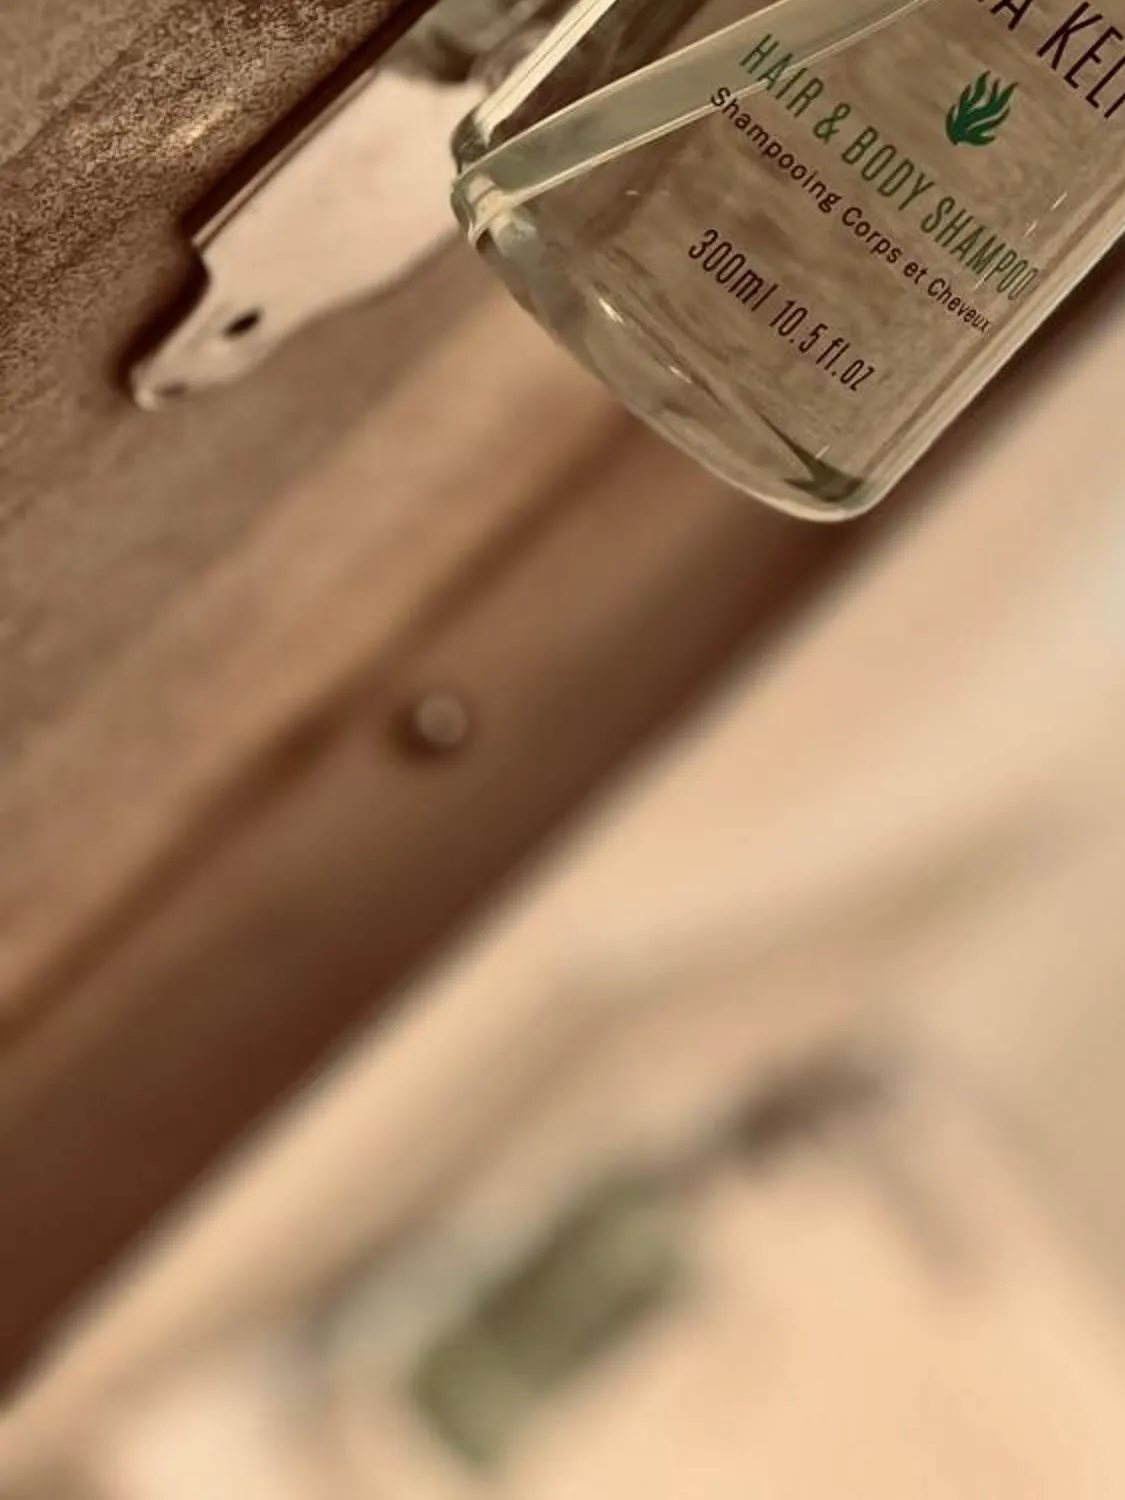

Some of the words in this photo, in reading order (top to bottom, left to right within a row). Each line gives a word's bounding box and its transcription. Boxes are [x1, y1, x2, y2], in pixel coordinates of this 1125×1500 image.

[710, 86, 843, 214] Shampooing
[842, 206, 904, 263] Corps
[903, 261, 928, 285] et
[927, 277, 990, 333] Cheveux
[739, 33, 825, 118] HAIR
[812, 103, 852, 144] &
[841, 125, 936, 212] BODY
[920, 196, 1039, 301] SHAMPOO
[688, 229, 779, 312] 300ml
[769, 300, 829, 353] 10.5
[815, 337, 875, 392] fl.oz
